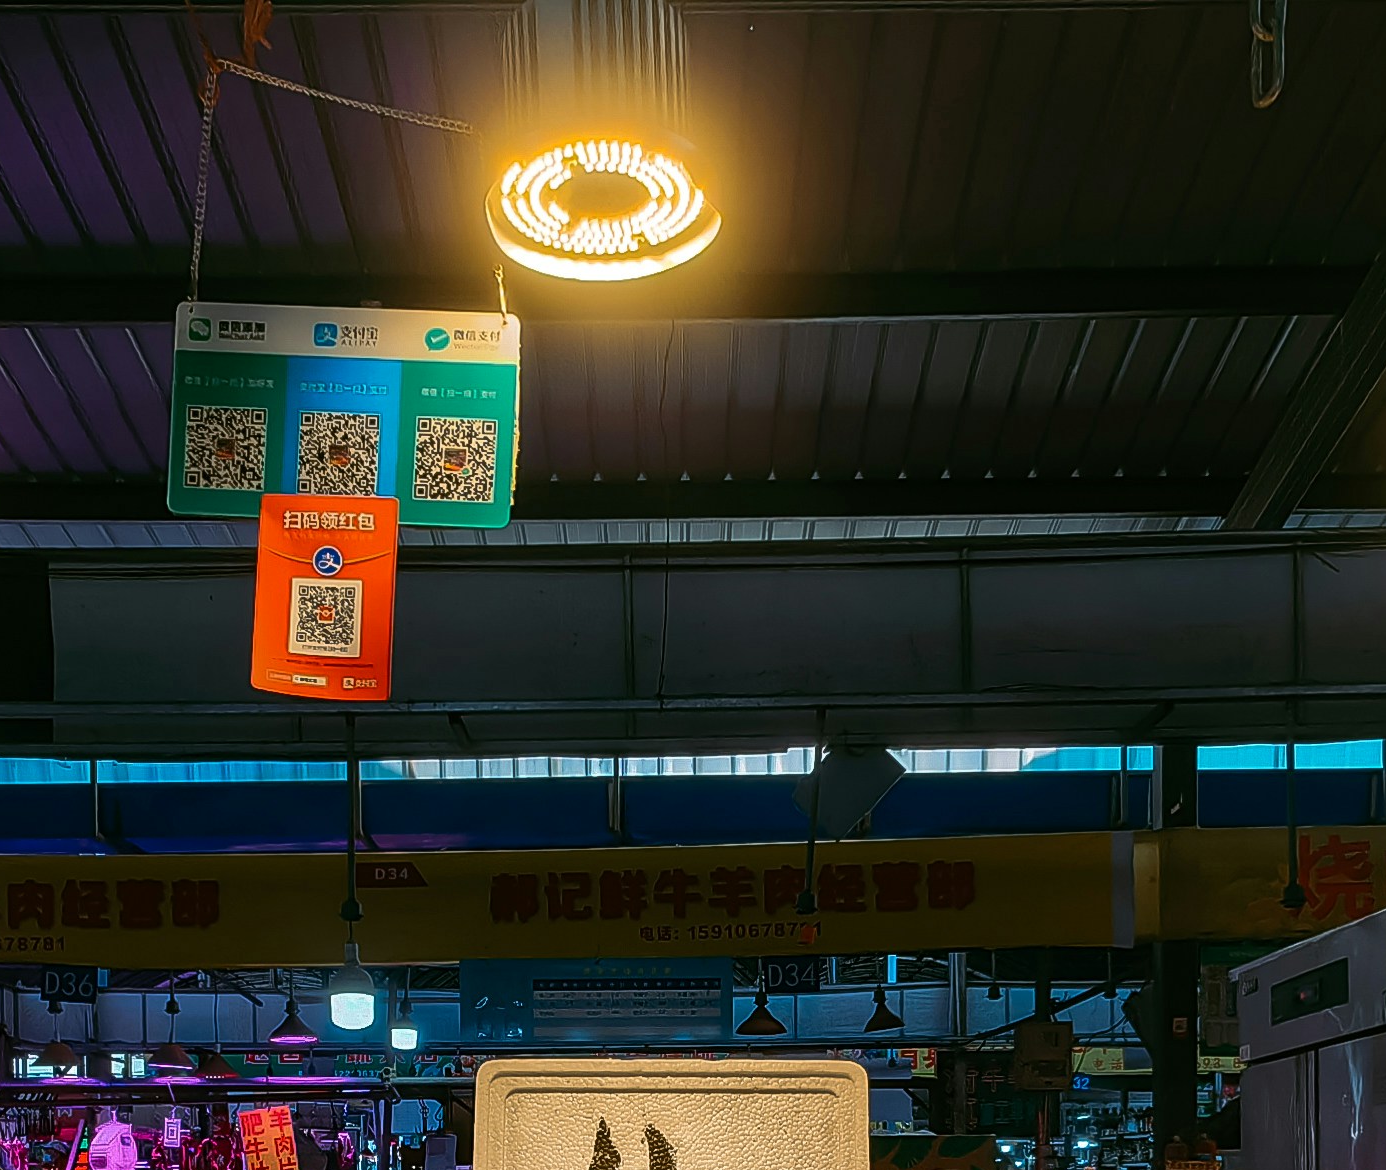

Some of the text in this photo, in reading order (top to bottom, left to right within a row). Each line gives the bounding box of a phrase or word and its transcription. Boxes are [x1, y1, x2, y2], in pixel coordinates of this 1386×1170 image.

[340, 325, 379, 341] 支付宝
[453, 329, 502, 342] 微信支付
[283, 510, 375, 531] 扫码领红包
[374, 867, 409, 880] D34
[686, 920, 823, 941] 1591067871
[44, 970, 95, 998] D36
[767, 963, 818, 988] D34
